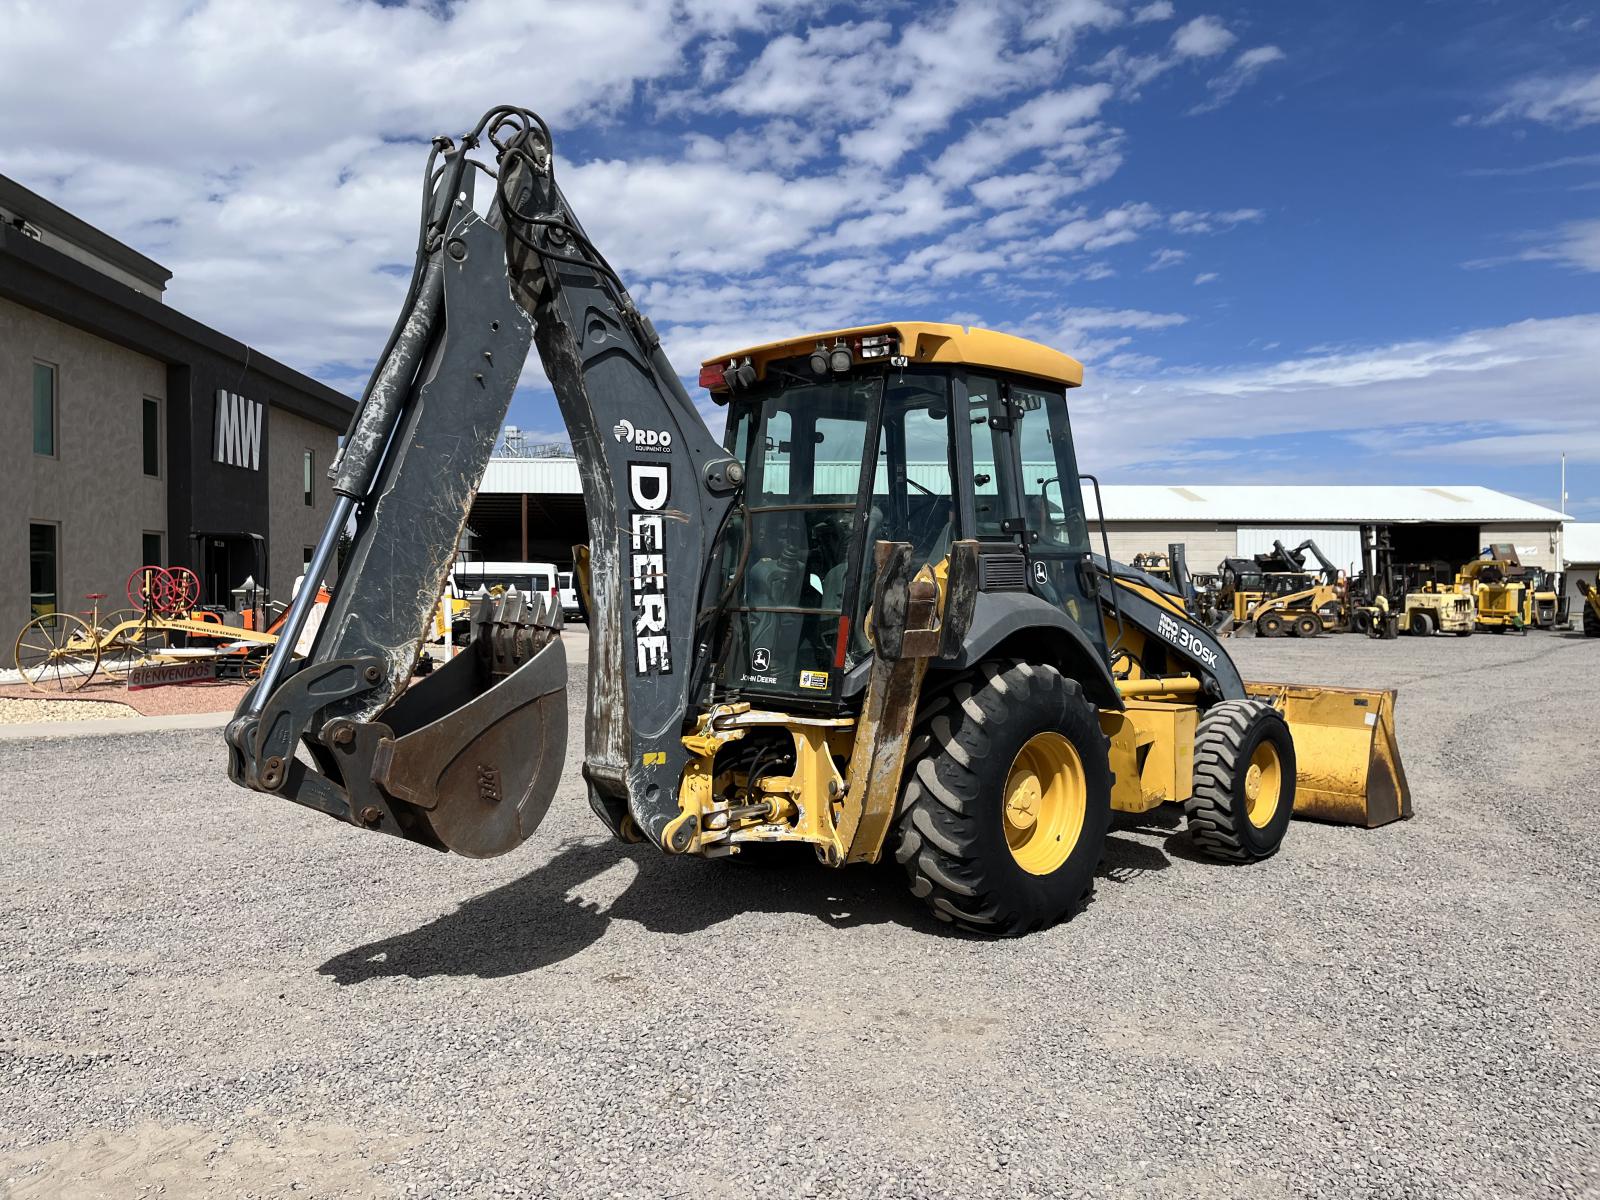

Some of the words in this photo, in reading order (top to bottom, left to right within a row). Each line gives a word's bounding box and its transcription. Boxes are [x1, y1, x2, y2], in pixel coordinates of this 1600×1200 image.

[215, 389, 263, 471] MW
[635, 429, 672, 447] RDO
[635, 445, 662, 453] EQUIPMENT
[630, 465, 670, 673] DEERE
[219, 630, 242, 638] SCRAPER
[1179, 628, 1218, 669] 310SK
[133, 664, 211, 684] BIENVENIDOS
[740, 673, 757, 682] JOHN
[756, 675, 778, 684] DEERE
